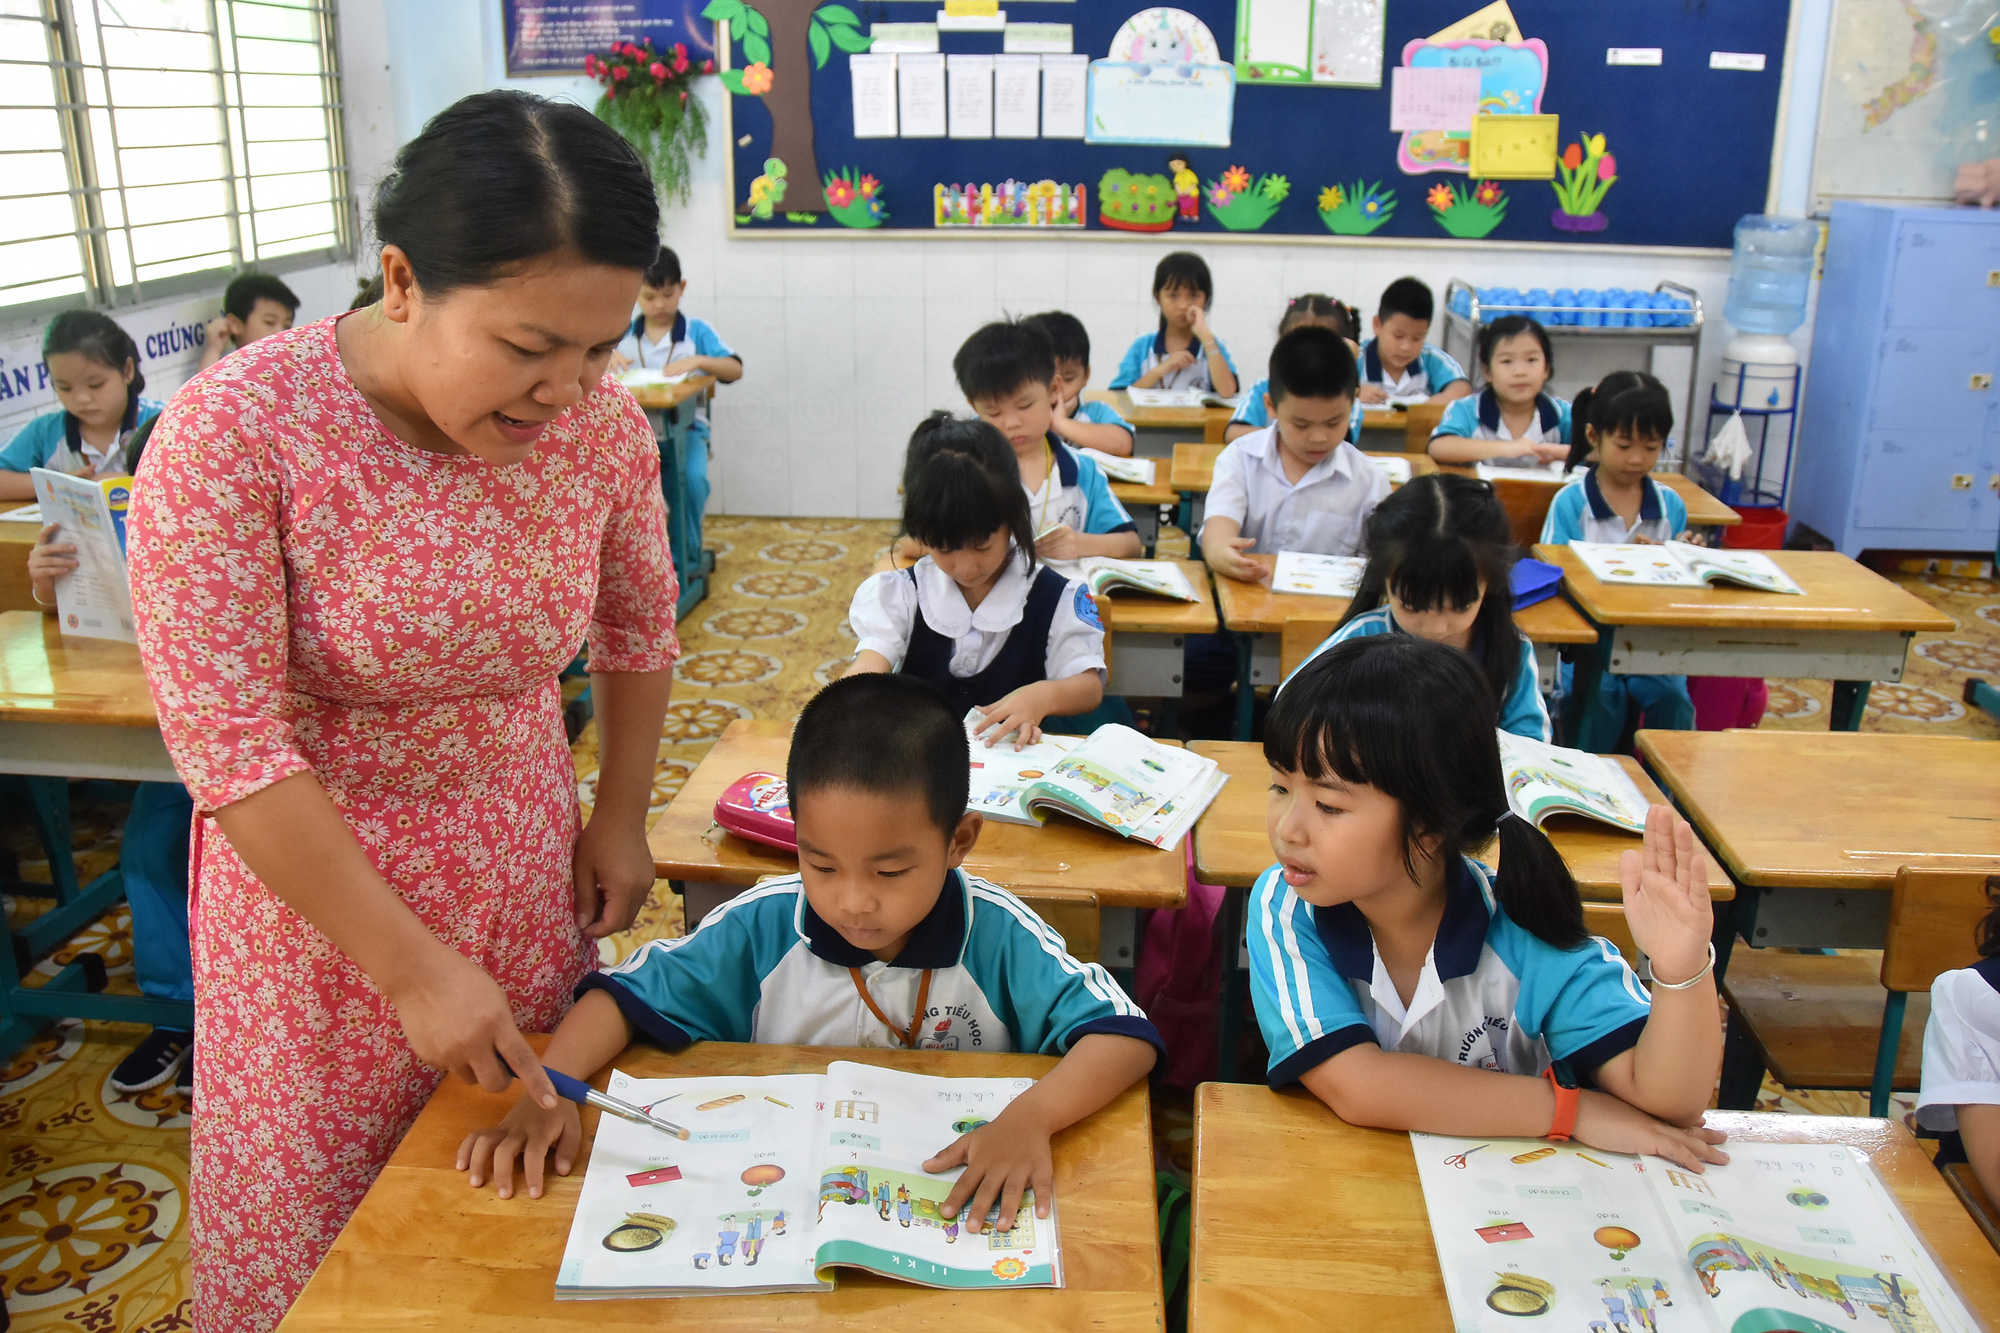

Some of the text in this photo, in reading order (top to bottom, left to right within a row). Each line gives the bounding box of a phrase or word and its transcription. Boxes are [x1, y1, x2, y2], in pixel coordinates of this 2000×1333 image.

[146, 321, 205, 359] CHÚNG
[945, 1003, 982, 1047] TIỂU HỌC
[1484, 1015, 1509, 1031] IỂU
[1610, 1212, 1620, 1220] bí
[891, 1255, 900, 1264] k
[908, 1259, 916, 1269] K
